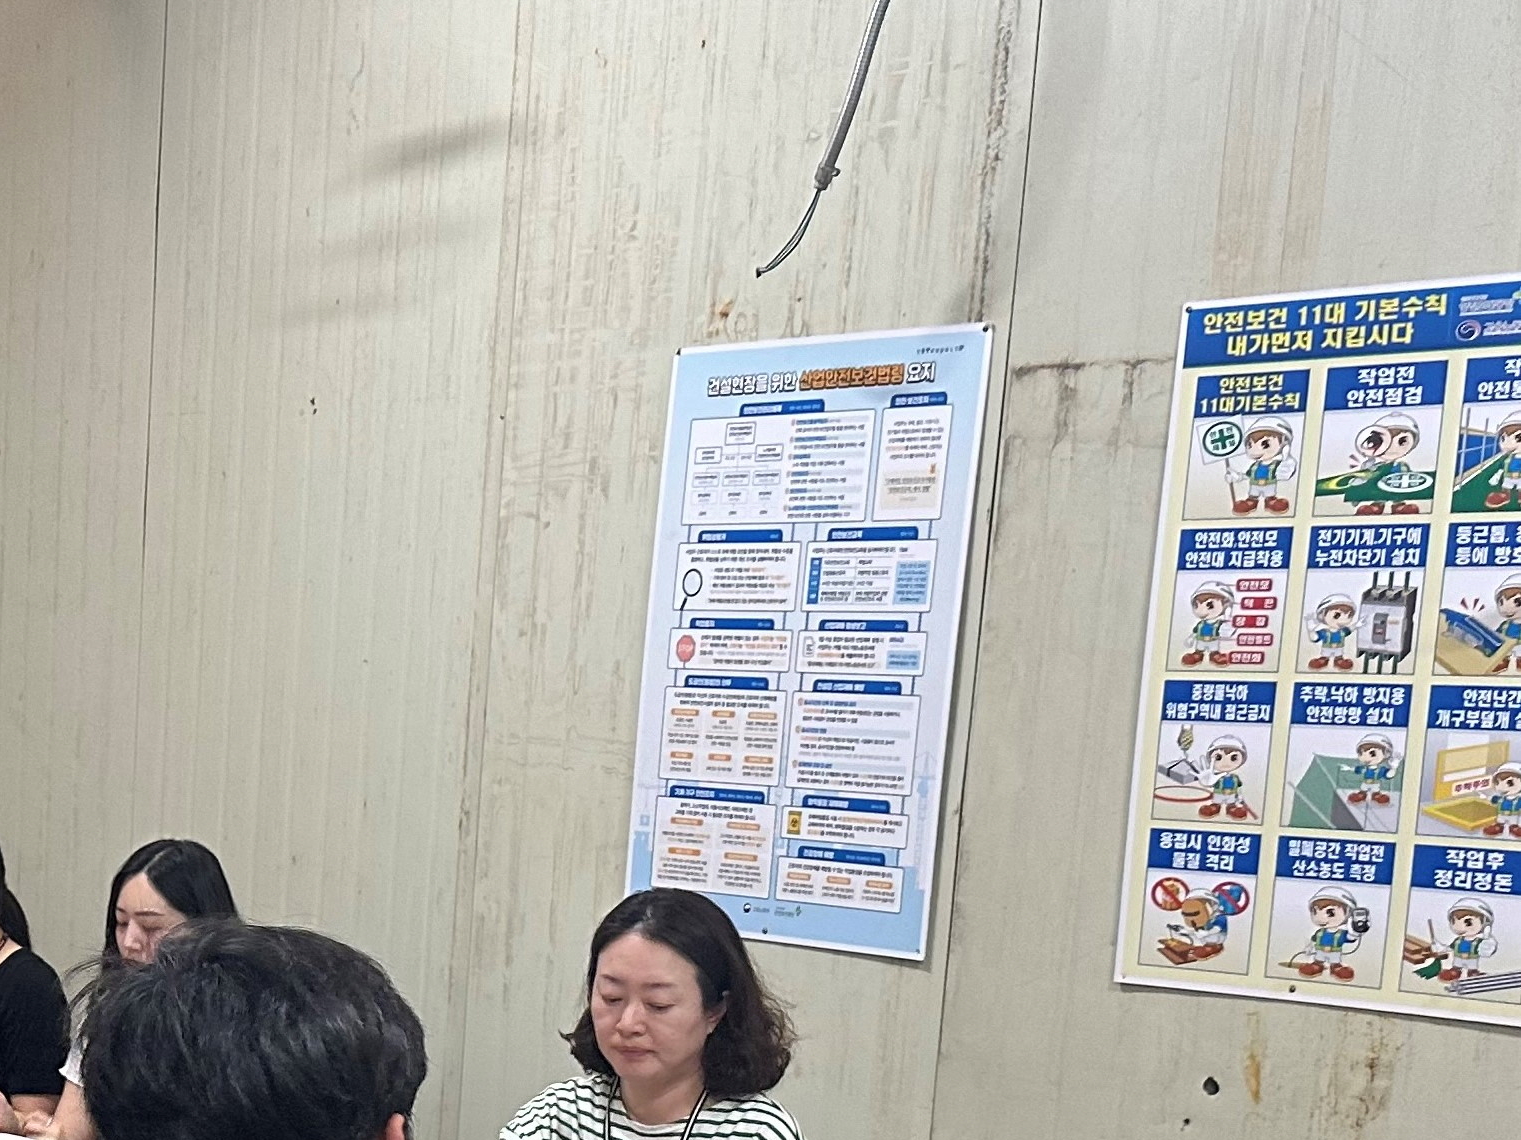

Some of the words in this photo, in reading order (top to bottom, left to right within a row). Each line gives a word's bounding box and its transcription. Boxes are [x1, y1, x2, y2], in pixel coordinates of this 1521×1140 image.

[1203, 308, 1287, 334] 안전보건
[1298, 302, 1345, 325] 11대
[1355, 293, 1448, 321] 기본수칙
[1227, 330, 1313, 356] 내가먼저
[708, 373, 768, 397] 건설현장을
[770, 371, 797, 392] 위한
[799, 363, 905, 390] 산업안전보건법령
[906, 361, 935, 383] 요지
[1219, 374, 1283, 394] 안전보건
[1357, 366, 1415, 386] 작업전
[1200, 392, 1300, 413] 11대기본수칙
[1347, 386, 1423, 407] 안전점검
[1185, 551, 1225, 568] 안전대
[1229, 550, 1283, 568] 지급착용
[1315, 548, 1386, 567] 누전차단기
[1391, 548, 1420, 566] 설치
[1191, 684, 1248, 701] 중량물낙하
[1363, 686, 1405, 705] 방지용
[1165, 702, 1222, 720] 위험구역내
[1225, 704, 1271, 721] 접근금지
[1306, 705, 1362, 724] 안전방망
[1366, 706, 1394, 725] 설치
[1435, 709, 1511, 729] 개구부덮개
[1160, 832, 1202, 850] 용접시
[1207, 834, 1251, 854] 인화성
[1344, 844, 1385, 862] 작업전
[1206, 854, 1234, 871] 격리
[1446, 849, 1505, 870] 작업후
[1293, 860, 1345, 879] 산소농도
[1349, 864, 1376, 882] 측정
[1434, 869, 1513, 892] 정리정돈
